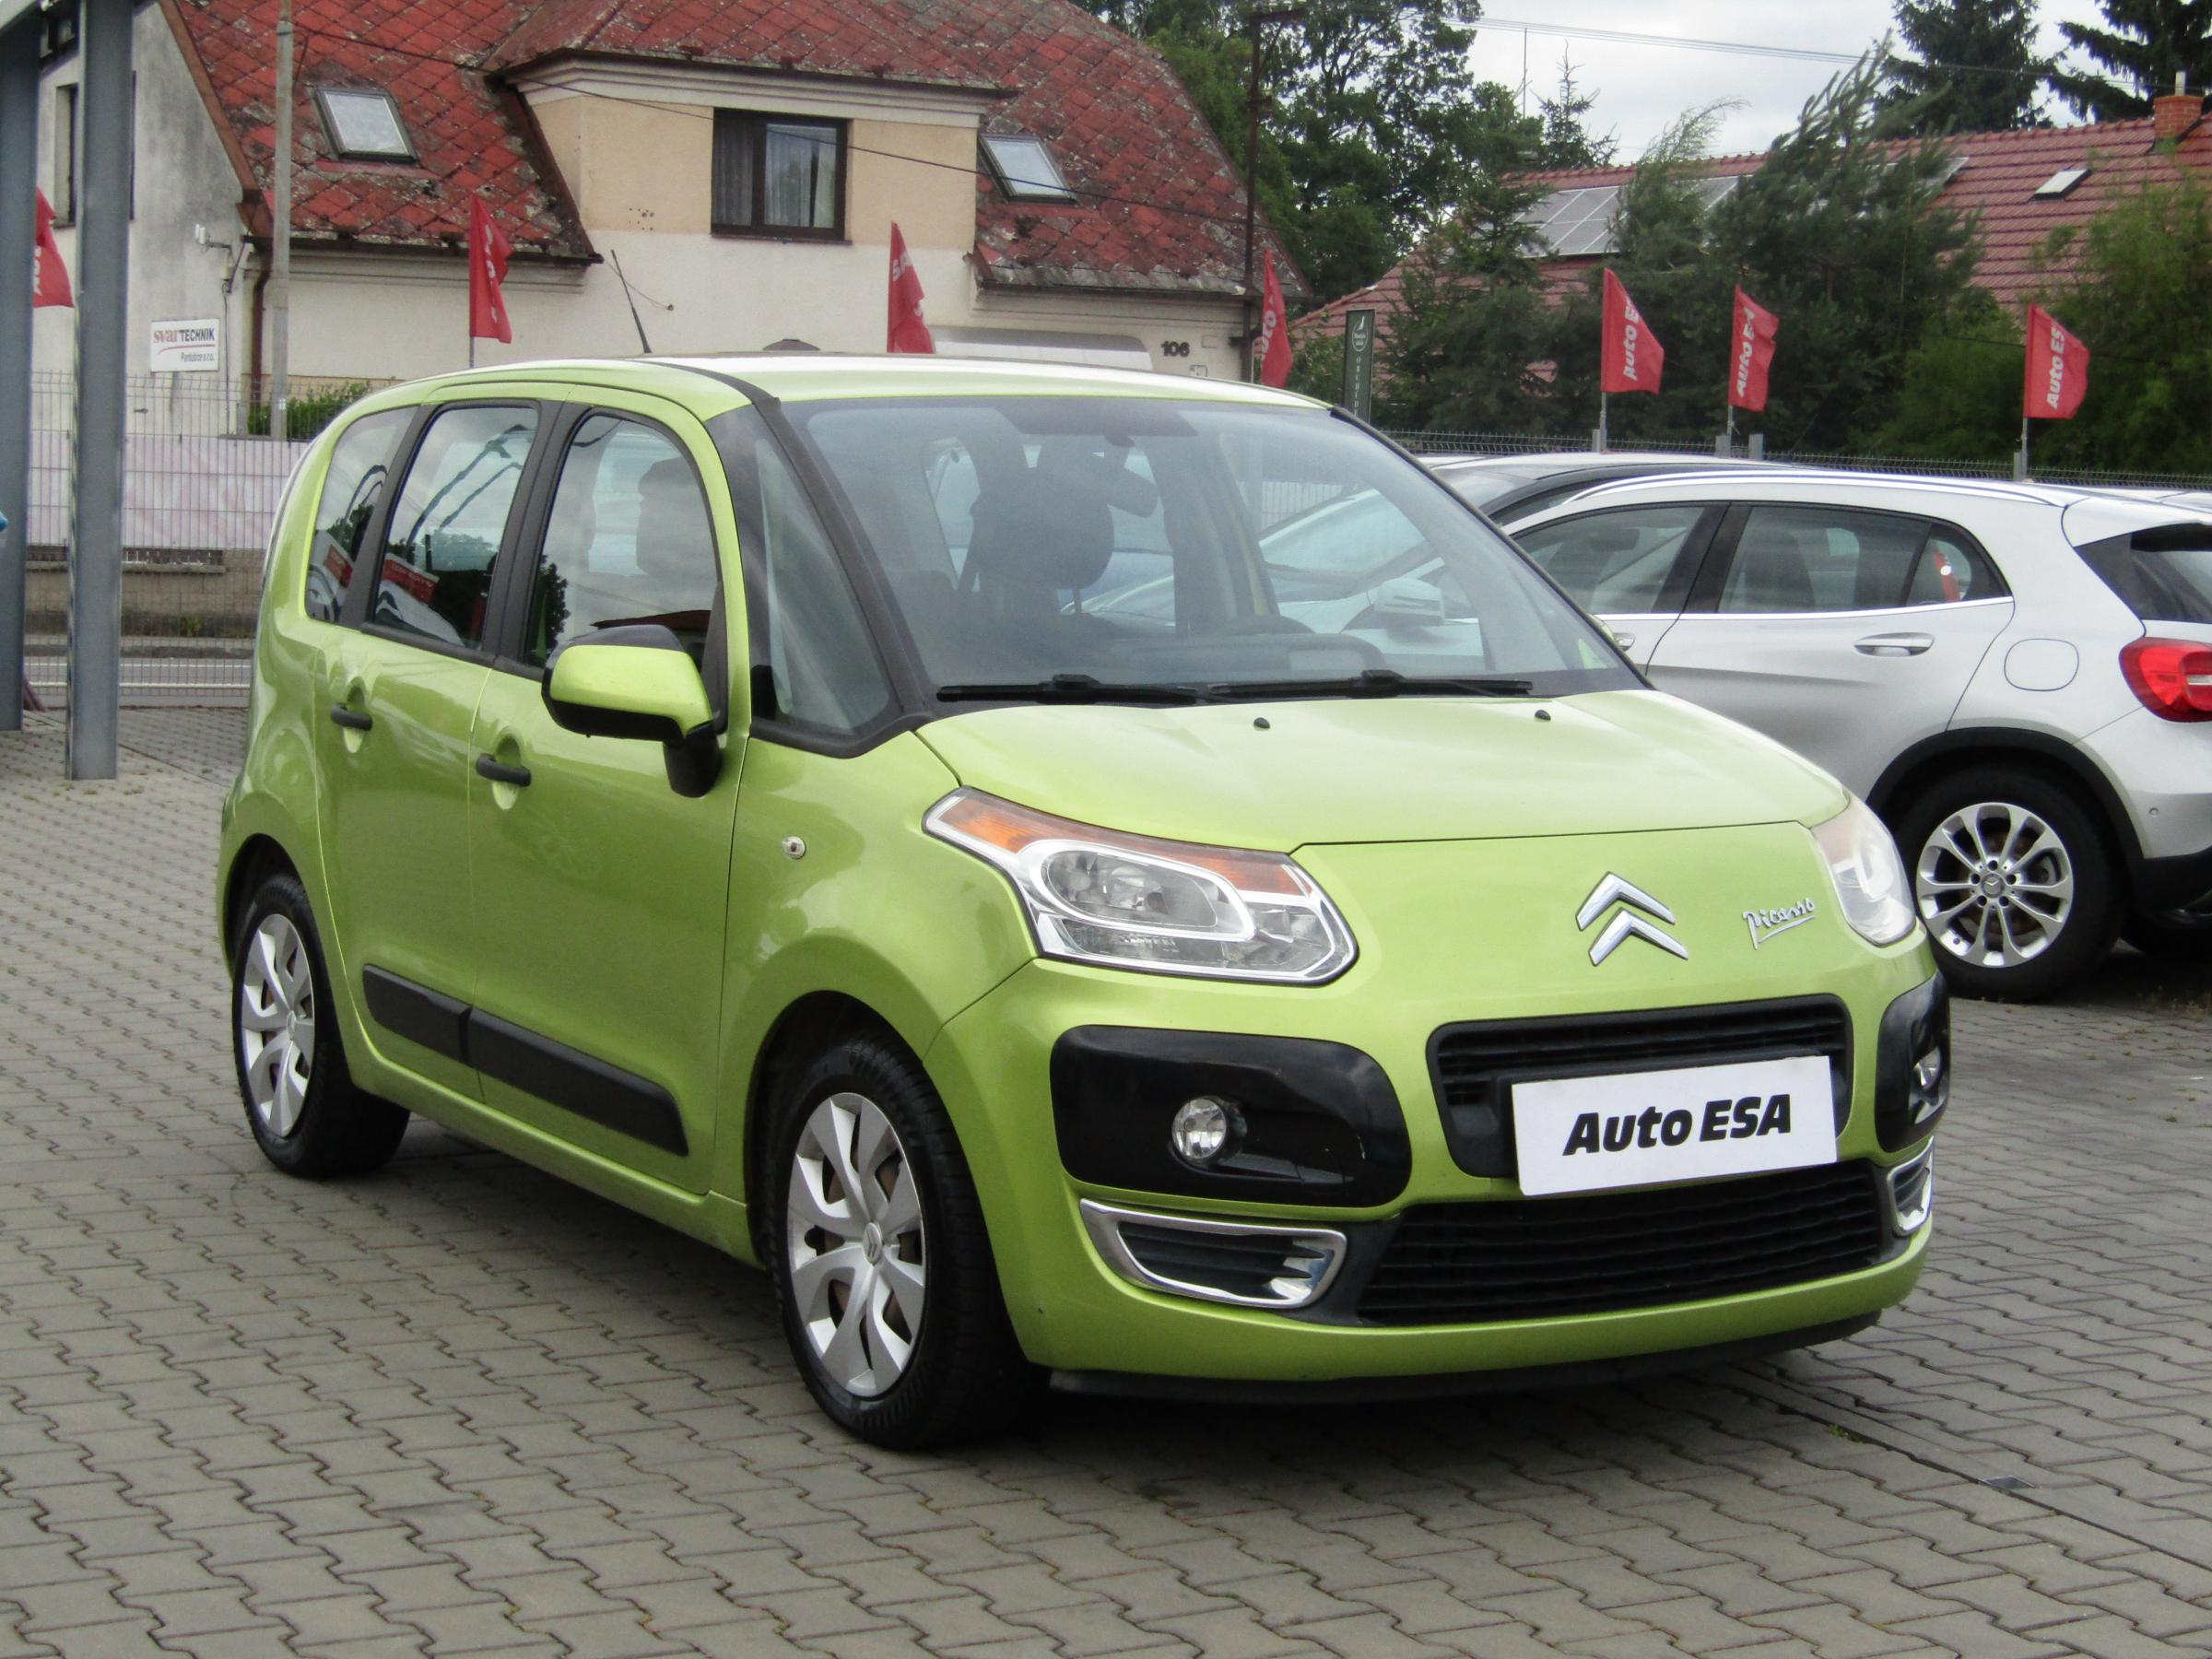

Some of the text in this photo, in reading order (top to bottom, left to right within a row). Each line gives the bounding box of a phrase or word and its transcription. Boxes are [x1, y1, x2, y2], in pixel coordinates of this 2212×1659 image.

[1623, 324, 1638, 381] Auto
[1736, 341, 1752, 397] Auto
[2046, 356, 2065, 409] Auto
[1562, 1094, 1791, 1157] Auto ESA
